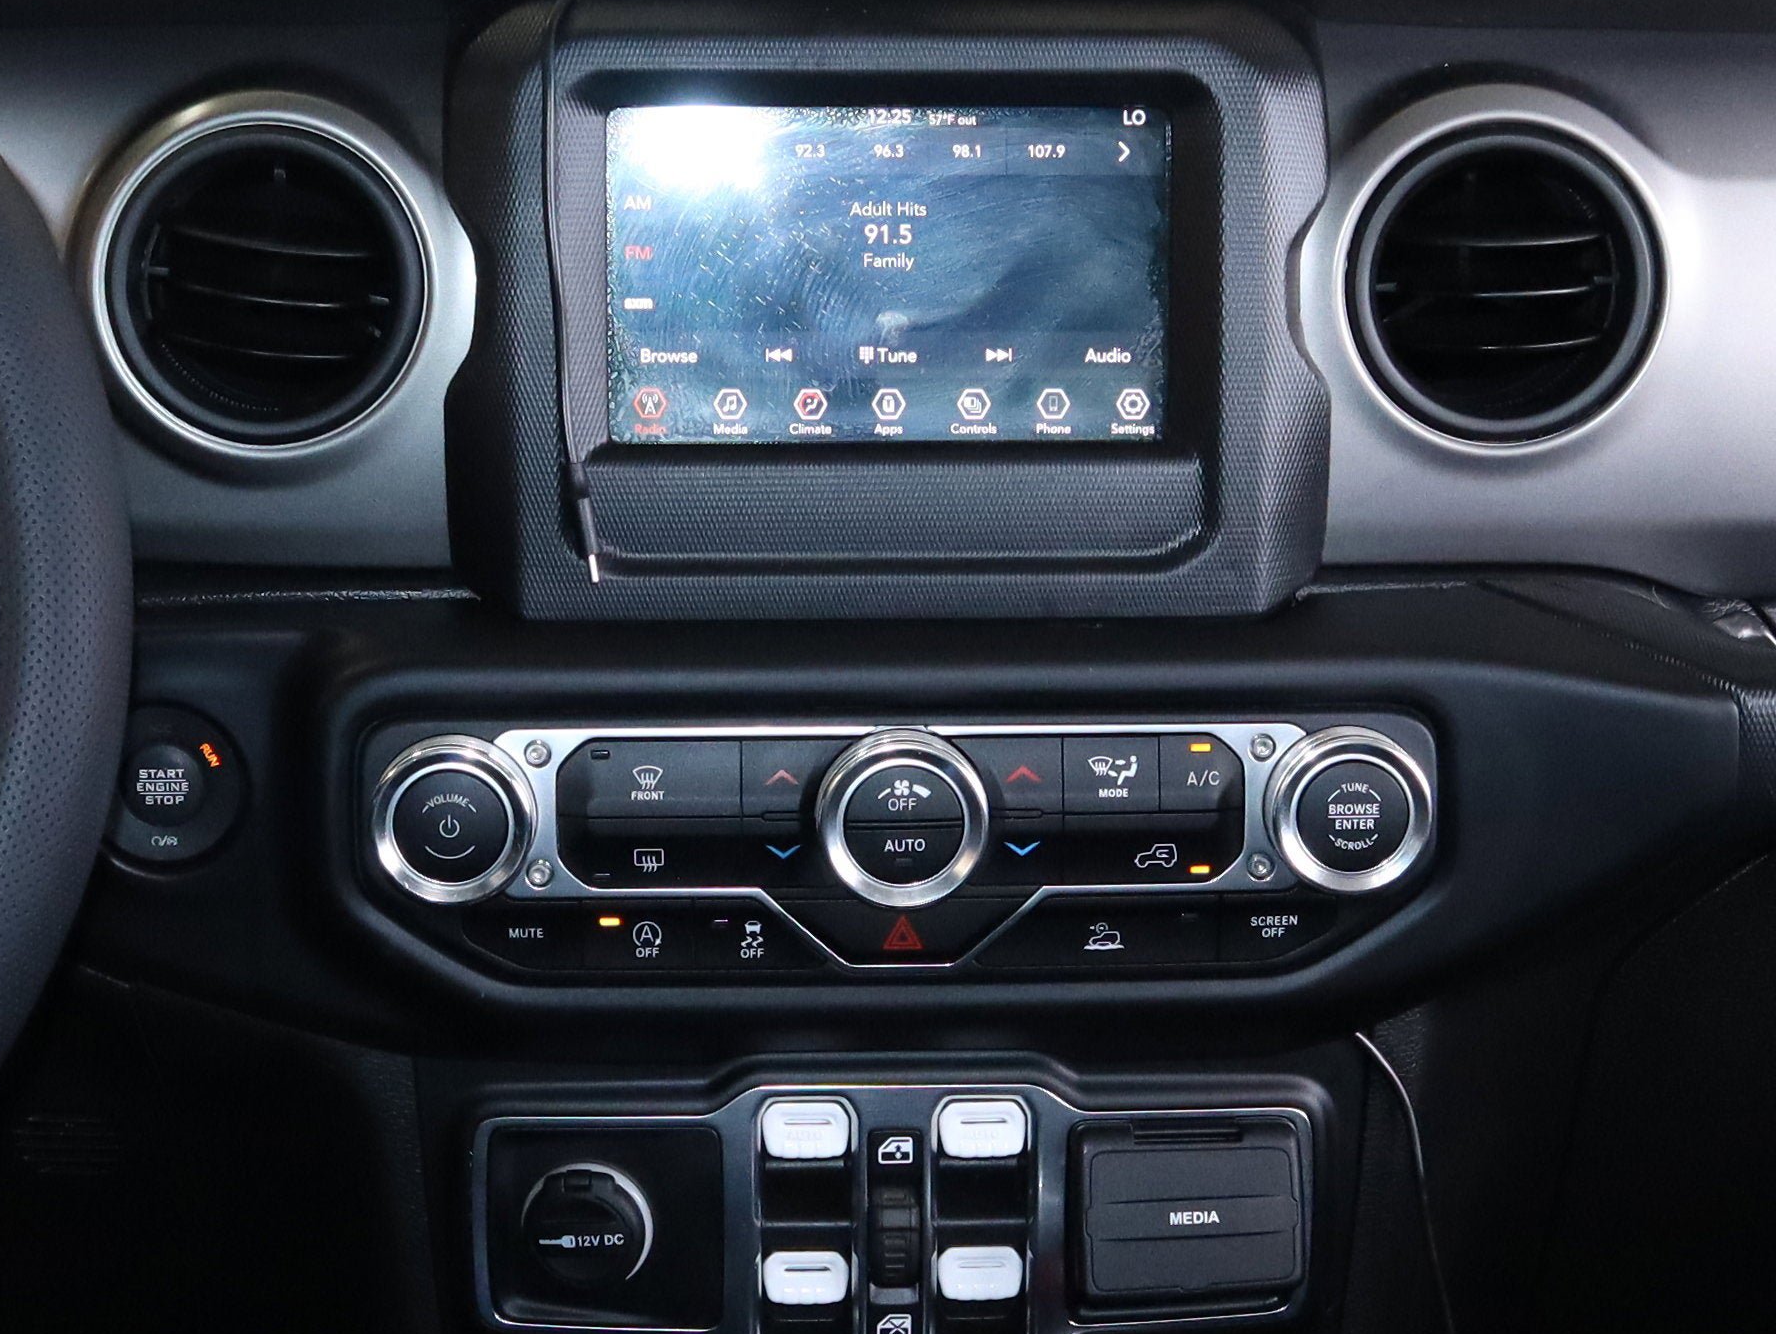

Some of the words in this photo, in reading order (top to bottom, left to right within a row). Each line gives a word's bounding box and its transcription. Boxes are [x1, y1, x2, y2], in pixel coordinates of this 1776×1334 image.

[869, 109, 912, 125] 12:25
[958, 114, 977, 127] out
[1123, 110, 1147, 126] LO
[795, 144, 826, 159] 92.3
[873, 144, 905, 159] 96.3
[952, 144, 982, 159] 98.1
[1027, 144, 1066, 159] 107.9
[624, 195, 652, 210] AM
[849, 201, 892, 217] Adult
[897, 201, 927, 217] Hits
[864, 225, 913, 244] 91.5
[624, 245, 653, 260] FM
[863, 253, 914, 271] Family
[640, 348, 698, 364] Browse
[877, 348, 917, 364] Tune
[1084, 348, 1132, 364] Audio
[634, 423, 667, 436] Radio
[713, 423, 748, 436] Media
[789, 423, 832, 436] Climate
[874, 423, 904, 438] Apps
[950, 423, 998, 436] Controls
[1035, 423, 1072, 436] Phone
[1110, 423, 1155, 438] Settings
[199, 742, 221, 768] RUN
[138, 768, 185, 779] START
[1186, 770, 1221, 788] A/C
[136, 781, 189, 792] ENGINE
[1098, 788, 1129, 798] MODE
[1340, 781, 1370, 795] TUNE
[144, 795, 185, 805] STOP
[426, 793, 470, 809] VOLUME
[630, 789, 665, 801] FRONT
[888, 797, 917, 812] OFF
[1327, 803, 1381, 816] BROWSE
[1334, 818, 1375, 831] ENTER
[884, 838, 926, 853] AUTO
[1334, 836, 1375, 852] SCROLL
[1250, 915, 1299, 927] SCREEN
[508, 927, 544, 940] MUTE
[1261, 927, 1286, 939] OFF
[635, 947, 661, 958] OFF
[740, 947, 765, 959] OFF
[1169, 1210, 1220, 1226] MEDIA
[577, 1232, 600, 1248] 12V
[603, 1232, 625, 1247] DC
